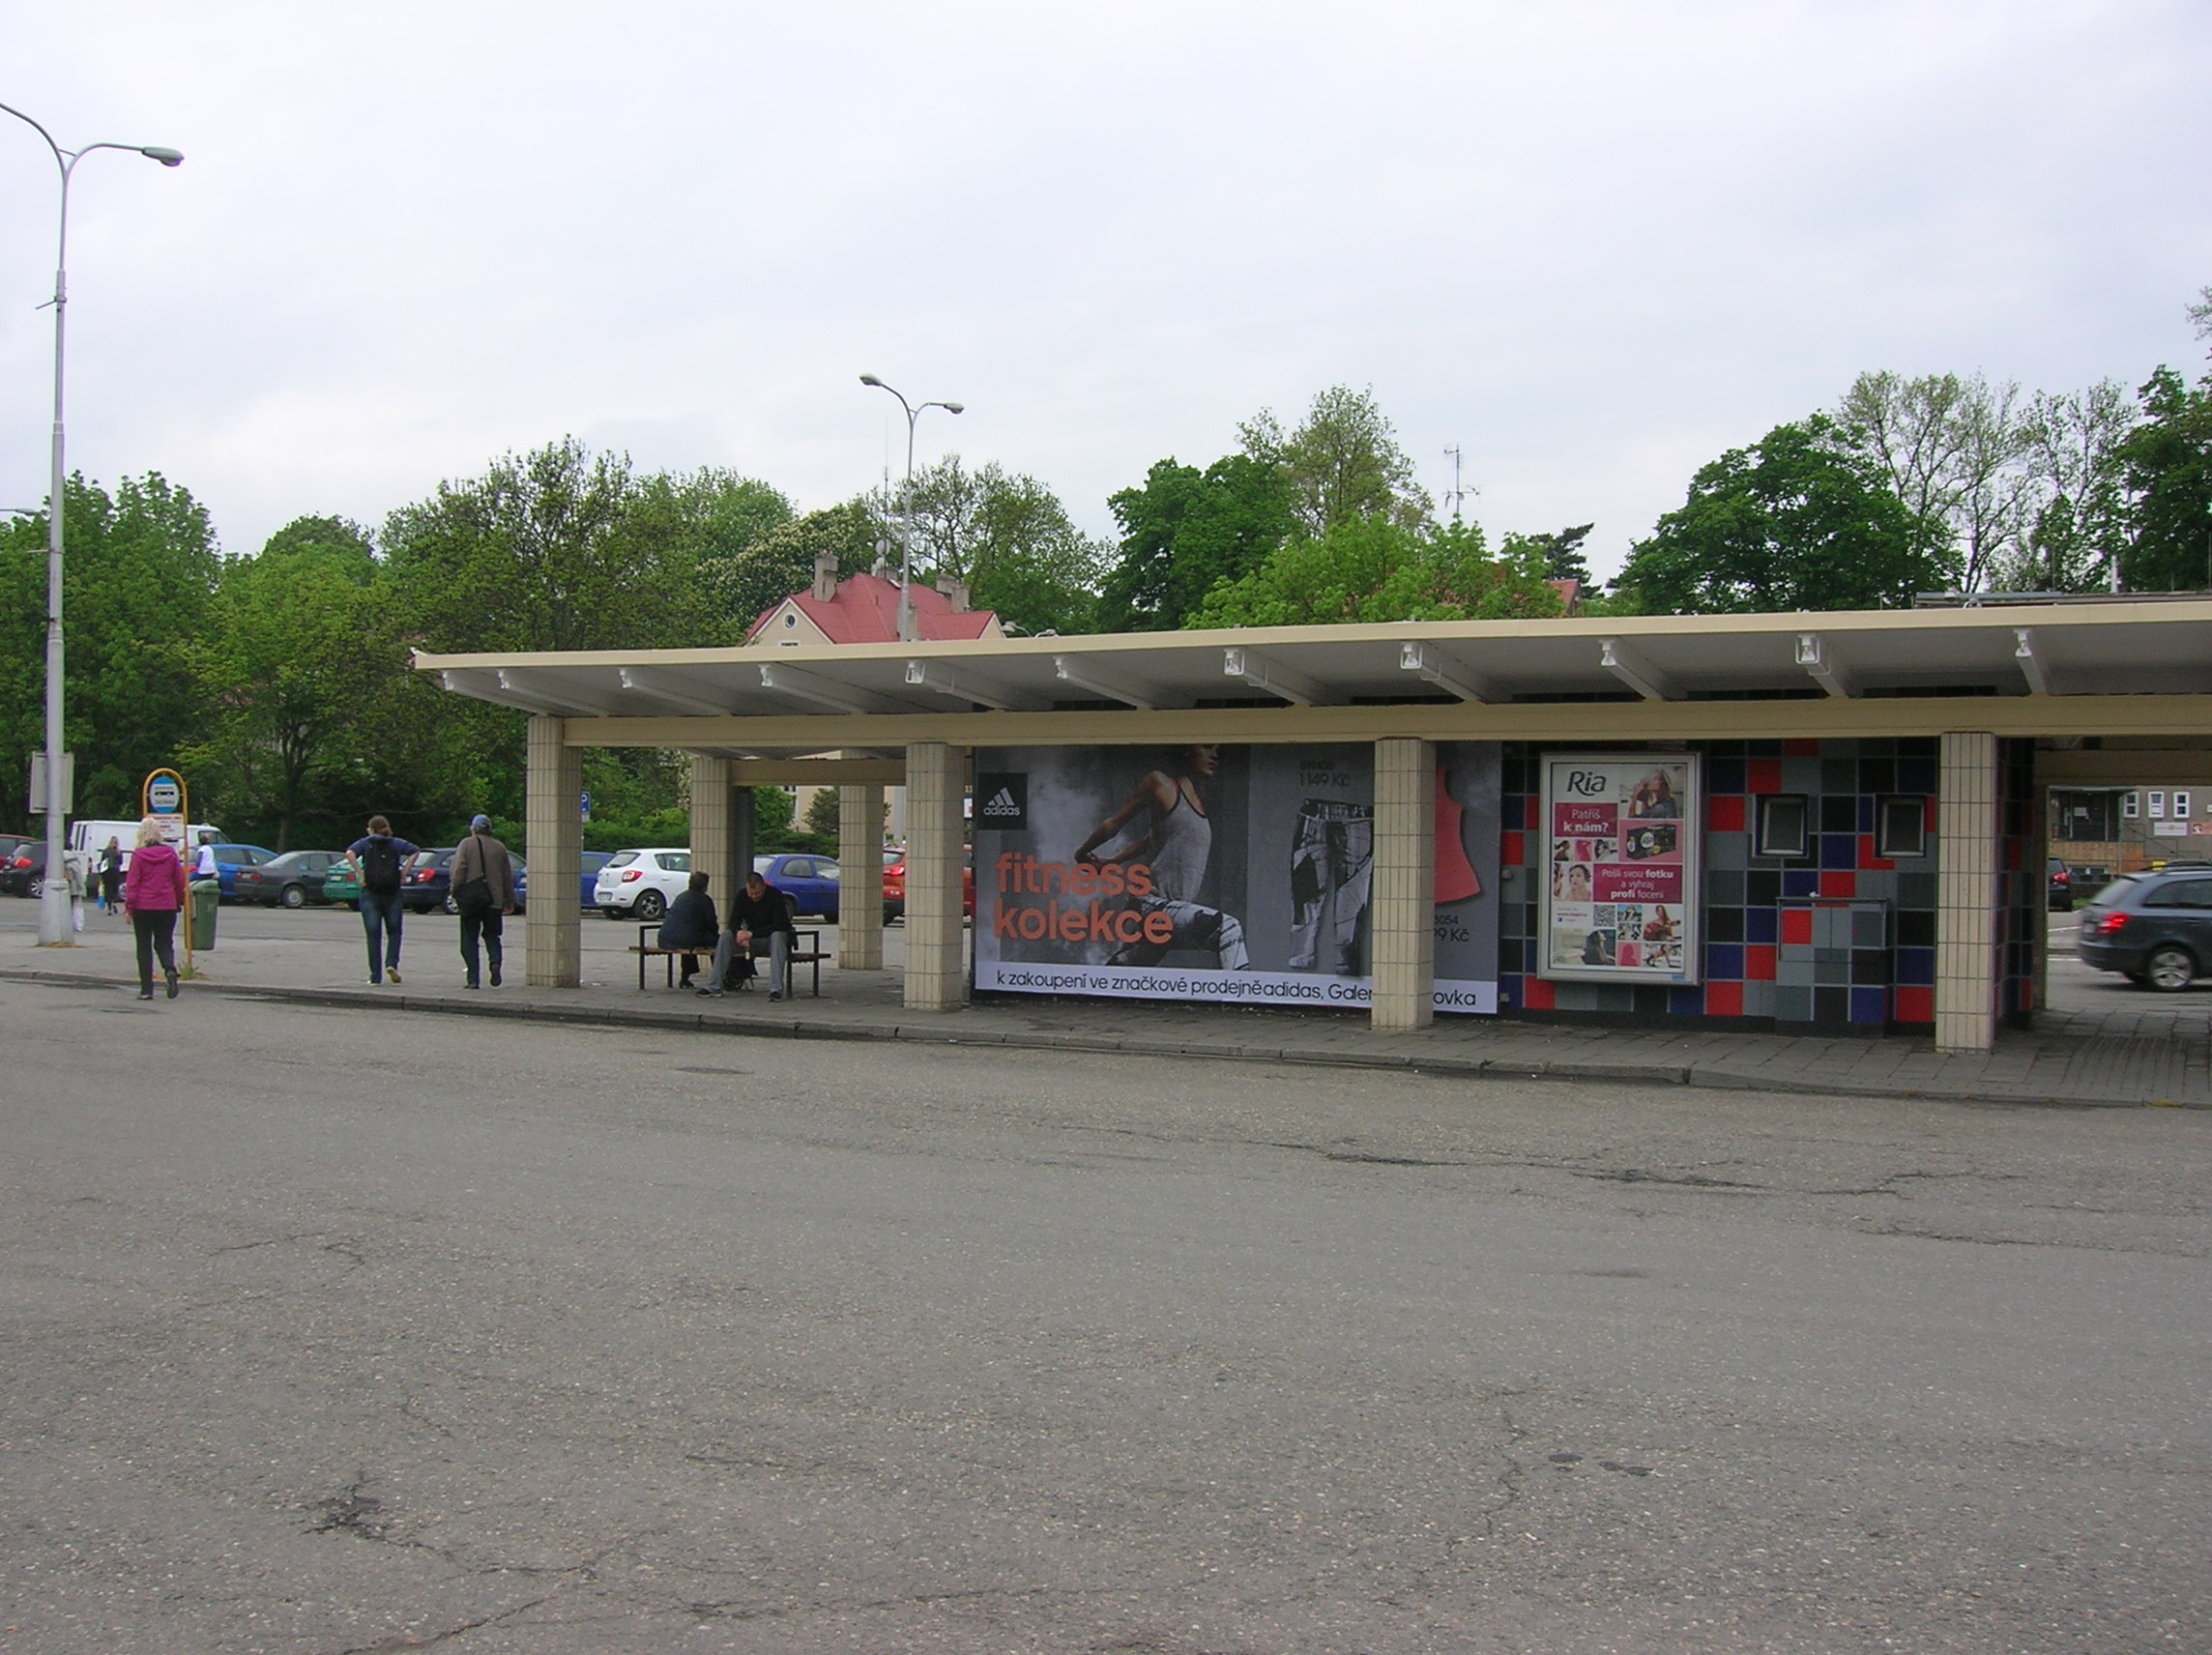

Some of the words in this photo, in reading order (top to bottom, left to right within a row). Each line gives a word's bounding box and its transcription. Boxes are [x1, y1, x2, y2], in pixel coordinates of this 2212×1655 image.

[1567, 770, 1607, 797] Ria
[983, 805, 1021, 816] adidas
[1562, 821, 1572, 832] k
[1575, 821, 1609, 832] nám?
[994, 851, 1153, 897] fitness
[1644, 869, 1674, 879] fotku
[1611, 889, 1636, 900] profi
[994, 898, 1175, 944] kolekce
[1450, 927, 1470, 943] Kč
[997, 971, 1004, 984] k
[1008, 972, 1087, 989] zakoupení
[1090, 976, 1109, 989] ve
[1112, 975, 1188, 993] značkové
[1191, 979, 1263, 998] prodejně
[1263, 982, 1324, 1000] adidas,
[1433, 989, 1476, 1005] ovka
